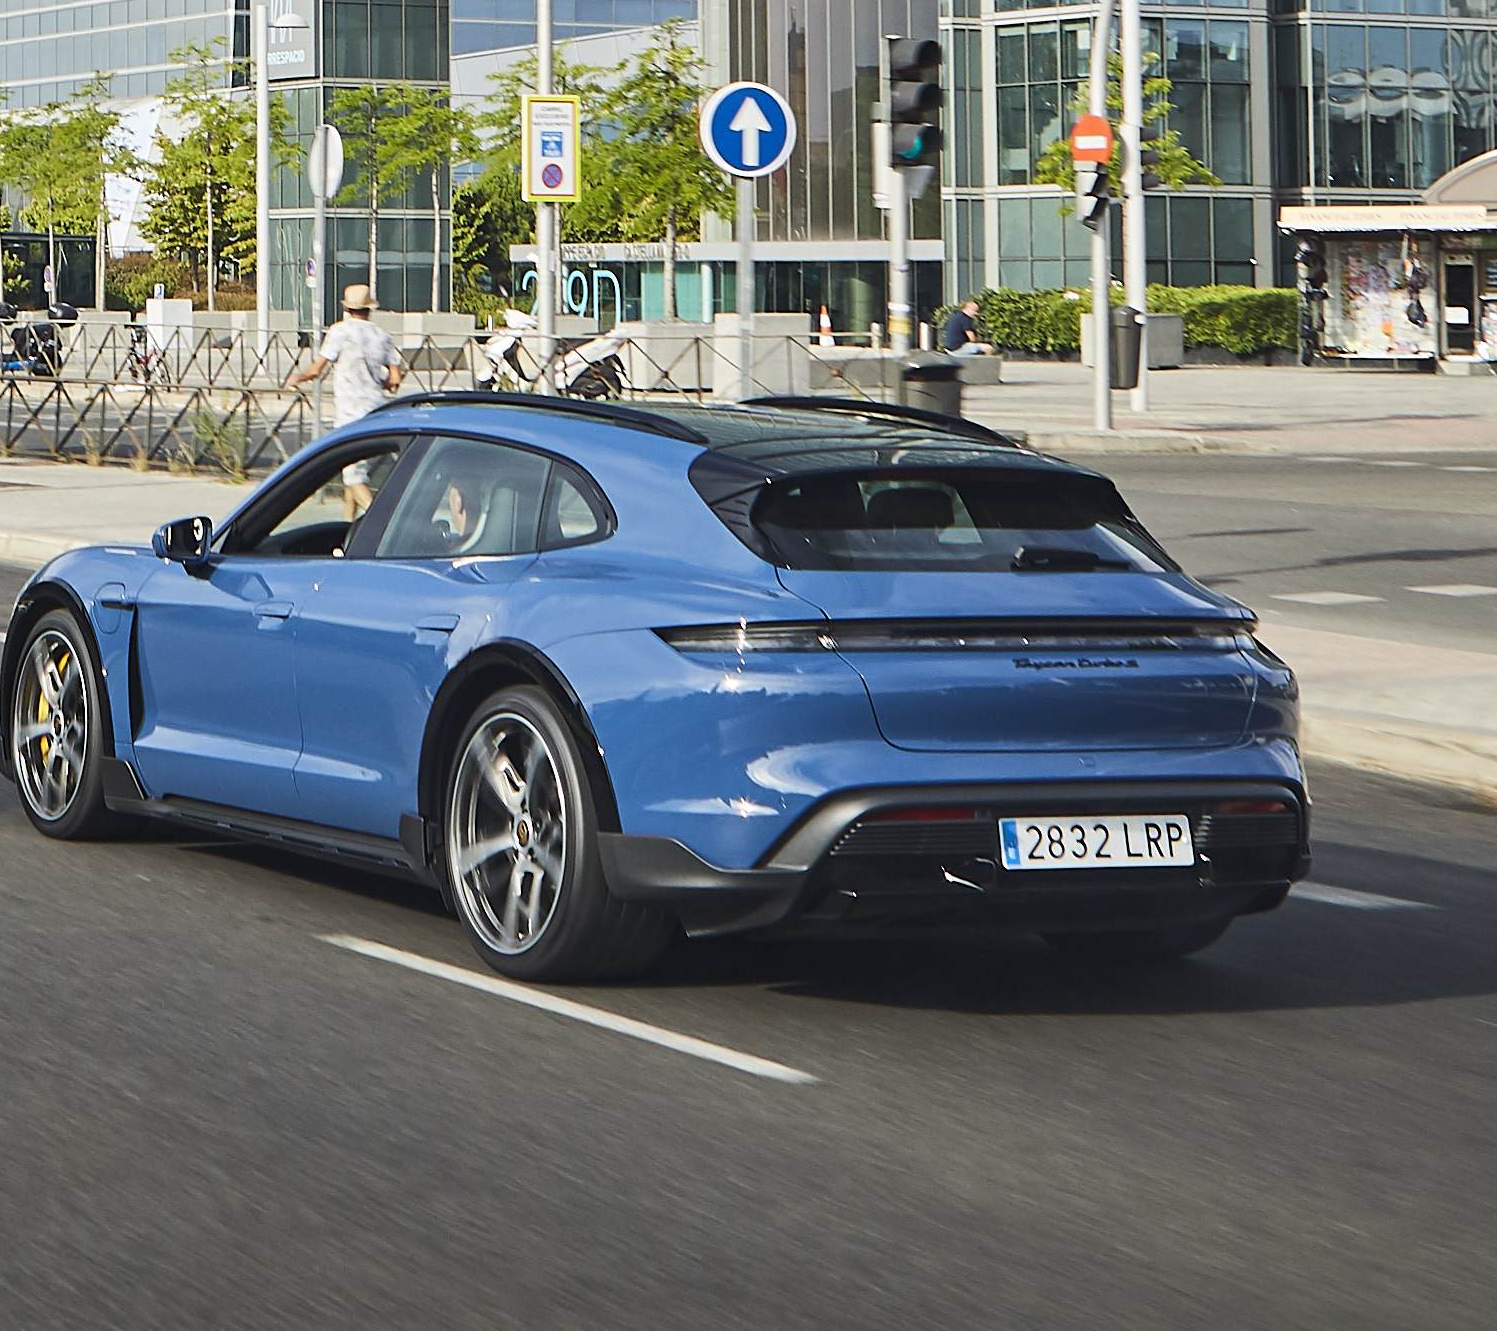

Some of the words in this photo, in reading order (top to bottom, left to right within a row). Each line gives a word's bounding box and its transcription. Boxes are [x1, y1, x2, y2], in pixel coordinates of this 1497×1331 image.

[1012, 657, 1077, 671] Taycan
[1077, 657, 1124, 669] Turbo
[1025, 824, 1112, 861] 2832
[1122, 821, 1184, 859] LRP
